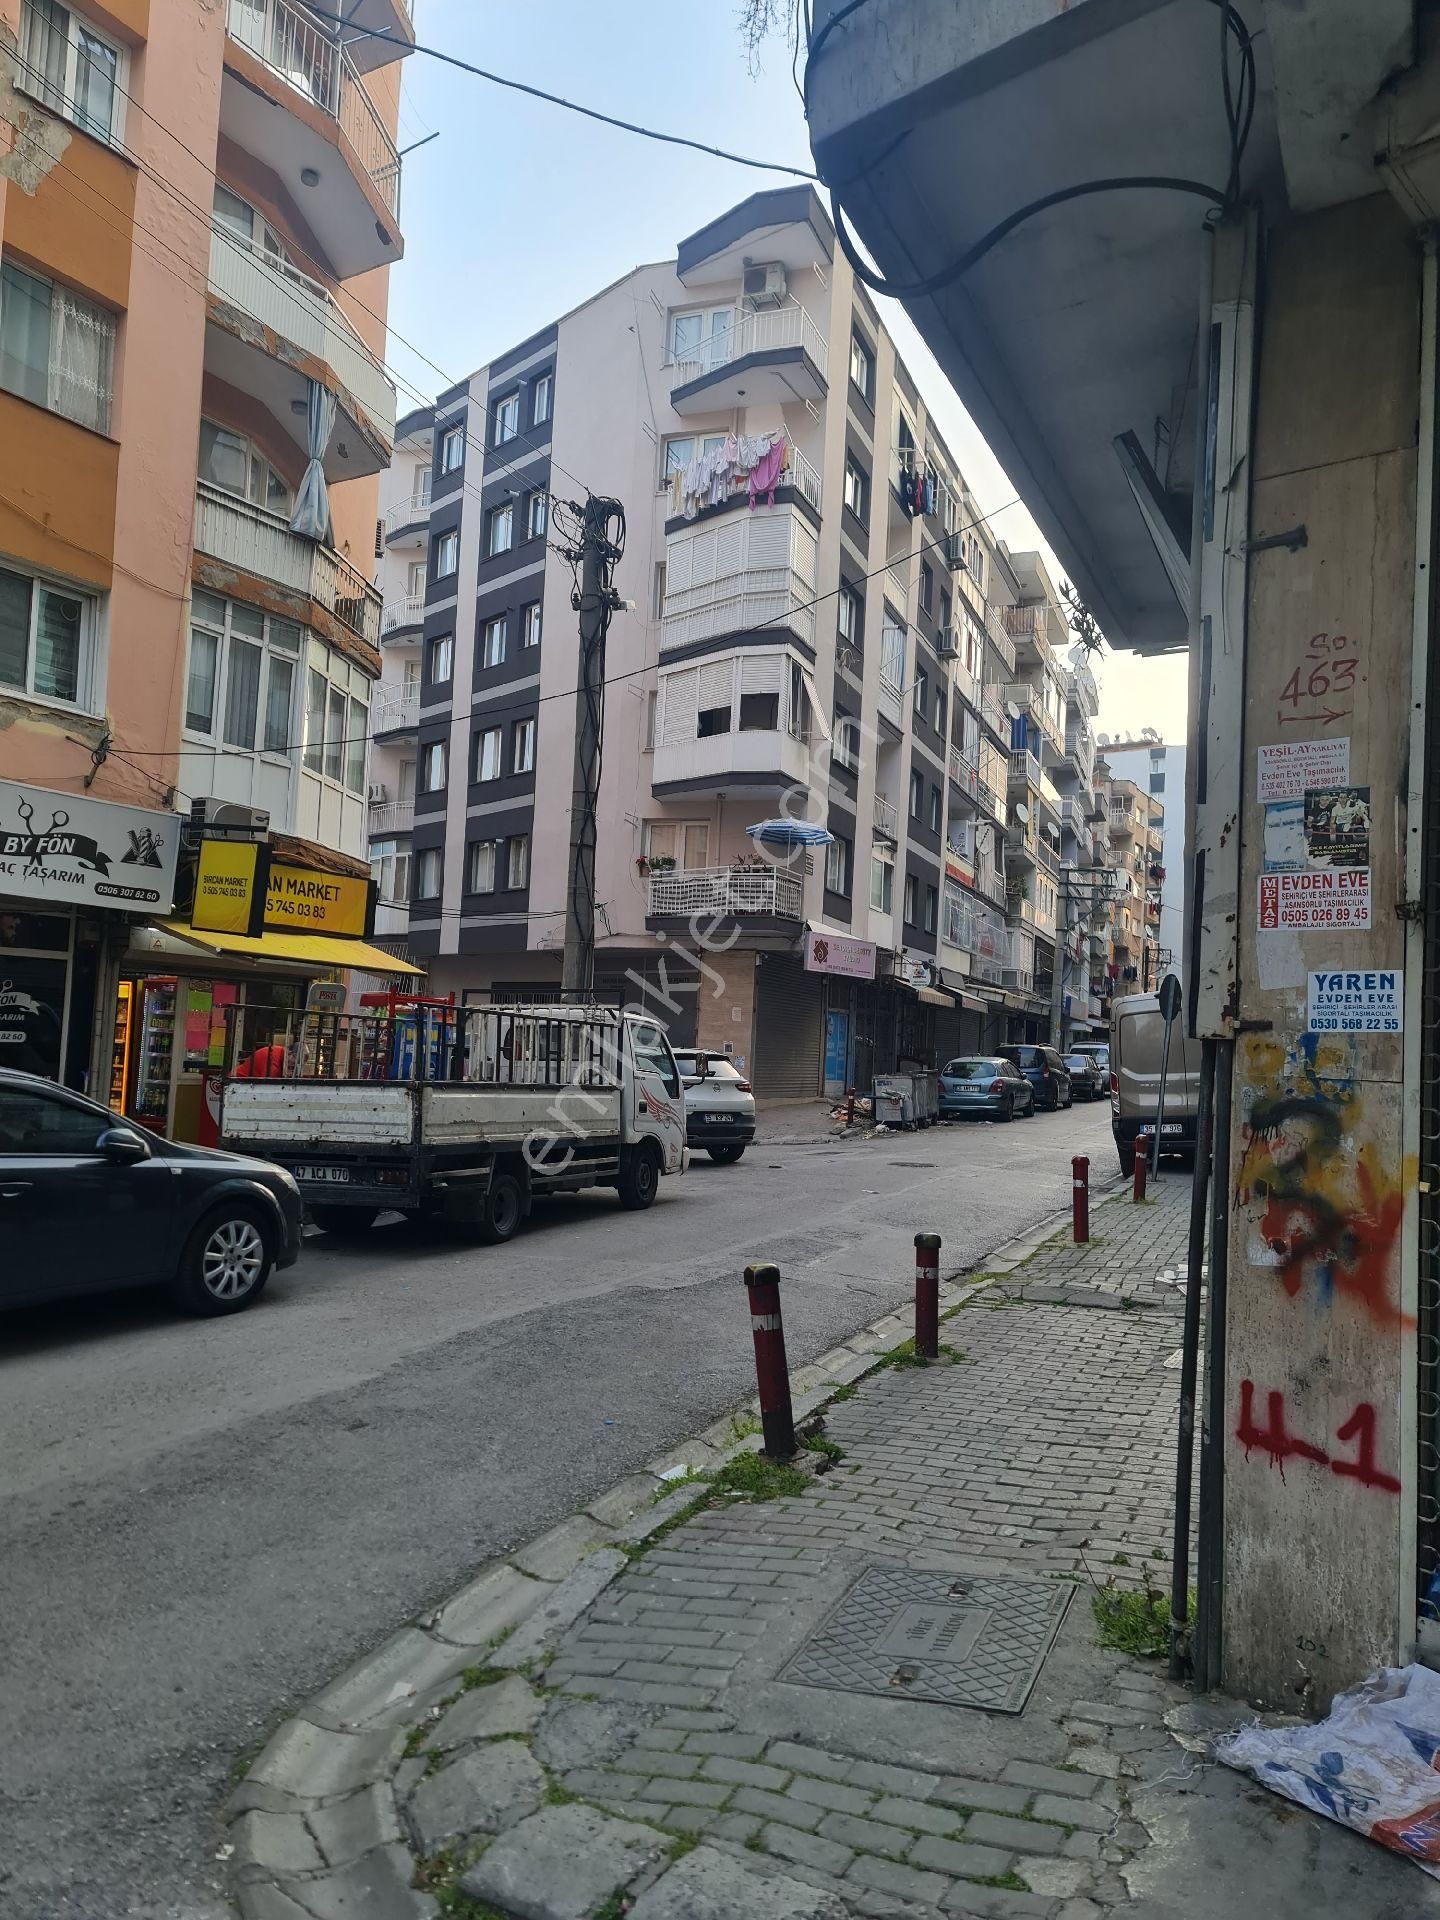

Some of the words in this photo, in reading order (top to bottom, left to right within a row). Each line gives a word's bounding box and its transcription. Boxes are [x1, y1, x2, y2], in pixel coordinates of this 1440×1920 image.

[1279, 659, 1359, 707] 463
[1262, 772, 1285, 780] Evden
[1286, 770, 1300, 778] Eve
[4, 836, 32, 853] BY
[36, 834, 76, 853] FÖN
[22, 864, 86, 885] TASARIM
[224, 876, 248, 886] MARKET
[1282, 874, 1333, 890] EVDEN
[1338, 872, 1368, 888] EVE
[98, 886, 118, 895] 0506
[120, 888, 134, 896] 307
[134, 890, 144, 898] 82
[146, 892, 156, 900] 60
[286, 878, 342, 902] MARKET
[276, 900, 295, 914] 745
[298, 903, 311, 916] 03
[312, 906, 326, 919] 83
[1282, 909, 1309, 922] 0505
[1312, 908, 1332, 921] 026
[1336, 908, 1350, 920] 89
[1354, 907, 1368, 920] 45
[1314, 973, 1395, 992] YAREN
[1318, 994, 1362, 1003] EVDEN
[1368, 994, 1394, 1003] EVE
[1310, 1018, 1338, 1030] 0530
[1342, 1018, 1362, 1030] 568
[1366, 1018, 1380, 1030] 22
[1384, 1018, 1398, 1030] 55
[296, 1166, 306, 1178] 47
[312, 1168, 326, 1180] ACA
[332, 1168, 348, 1180] 070
[905, 1616, 937, 1641] TÜRK
